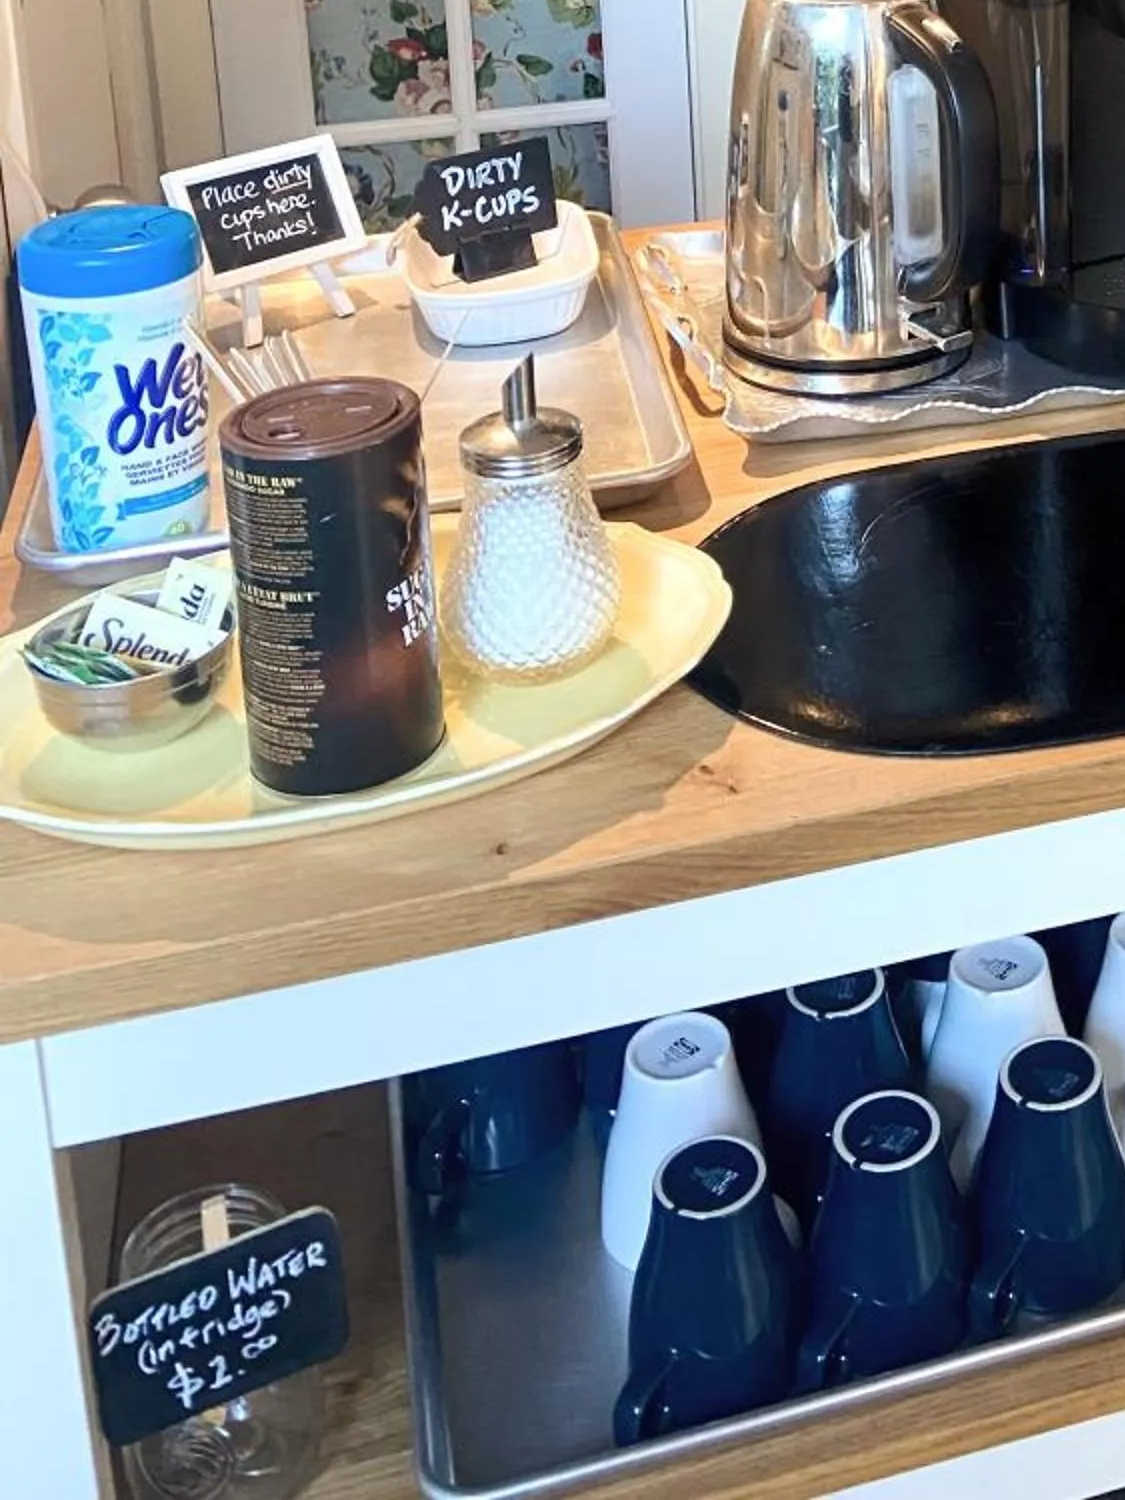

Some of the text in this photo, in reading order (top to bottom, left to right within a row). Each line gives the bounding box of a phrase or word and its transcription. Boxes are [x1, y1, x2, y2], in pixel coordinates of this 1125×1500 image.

[201, 163, 312, 211] Place dirty
[440, 151, 522, 196] DIRTY
[220, 204, 266, 232] cups
[232, 211, 317, 251] Thanks!
[441, 185, 540, 231] K-CUPS
[84, 617, 191, 667] Splend
[227, 1241, 328, 1300] WATER
